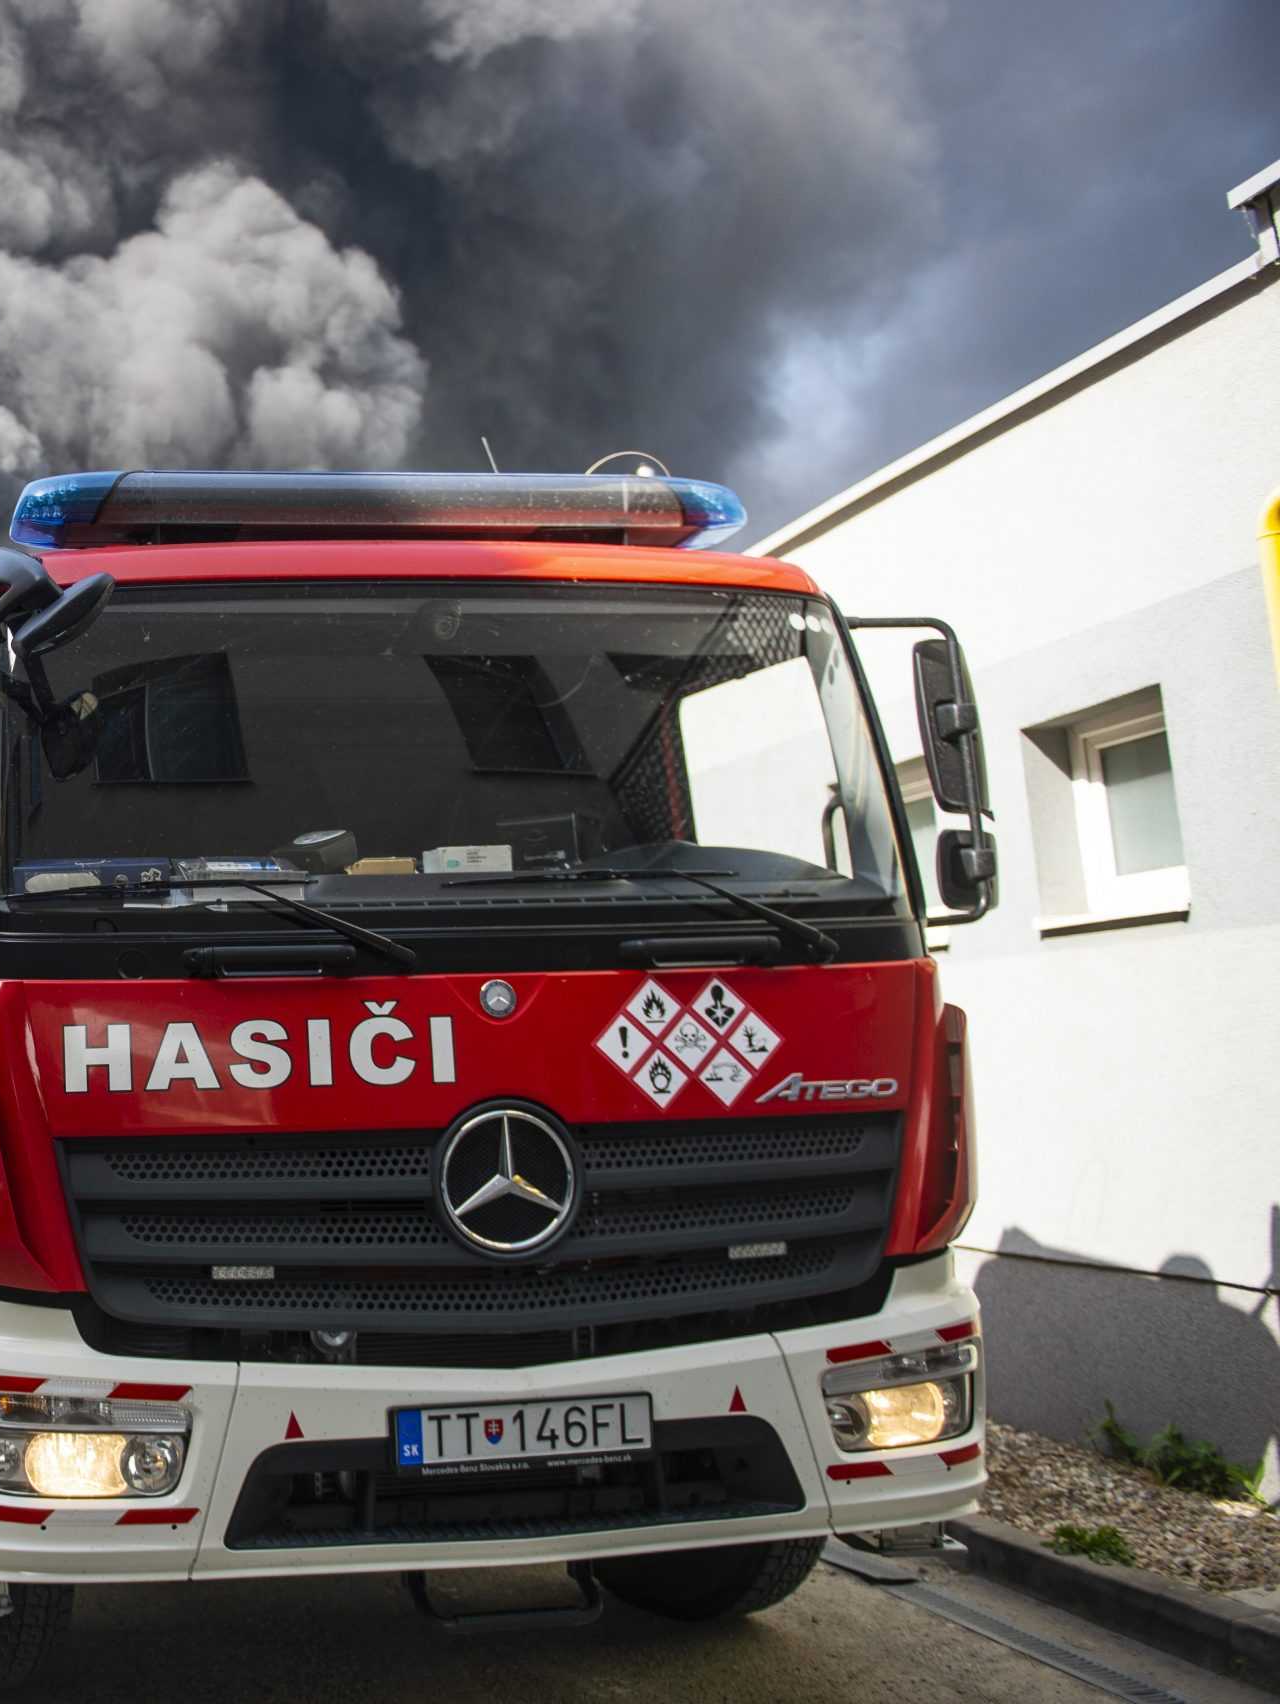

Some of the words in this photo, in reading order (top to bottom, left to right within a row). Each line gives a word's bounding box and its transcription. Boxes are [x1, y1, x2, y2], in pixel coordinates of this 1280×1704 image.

[62, 1000, 456, 1093] HASIČI
[403, 1444, 419, 1457] SK
[427, 1412, 480, 1458] TT
[512, 1403, 644, 1452] 146FL
